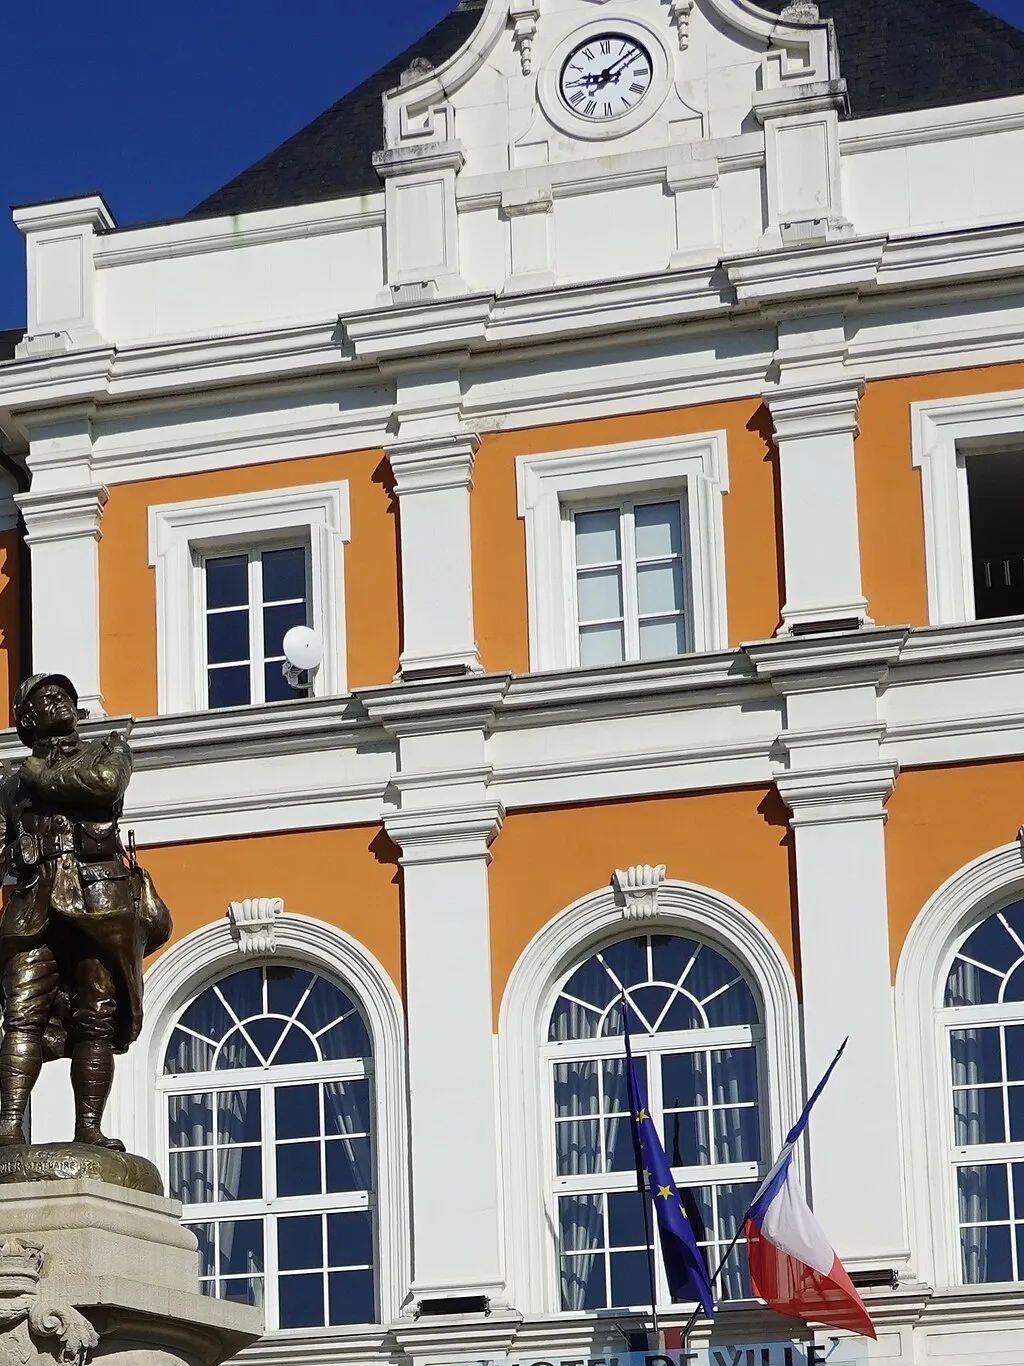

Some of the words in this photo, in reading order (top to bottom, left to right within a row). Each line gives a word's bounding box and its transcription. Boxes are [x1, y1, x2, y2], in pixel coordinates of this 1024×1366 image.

[600, 40, 611, 55] XII
[582, 48, 595, 62] XI
[569, 64, 584, 72] X
[633, 68, 648, 77] III
[584, 100, 597, 116] VII
[604, 102, 613, 116] VI
[621, 96, 631, 109] V
